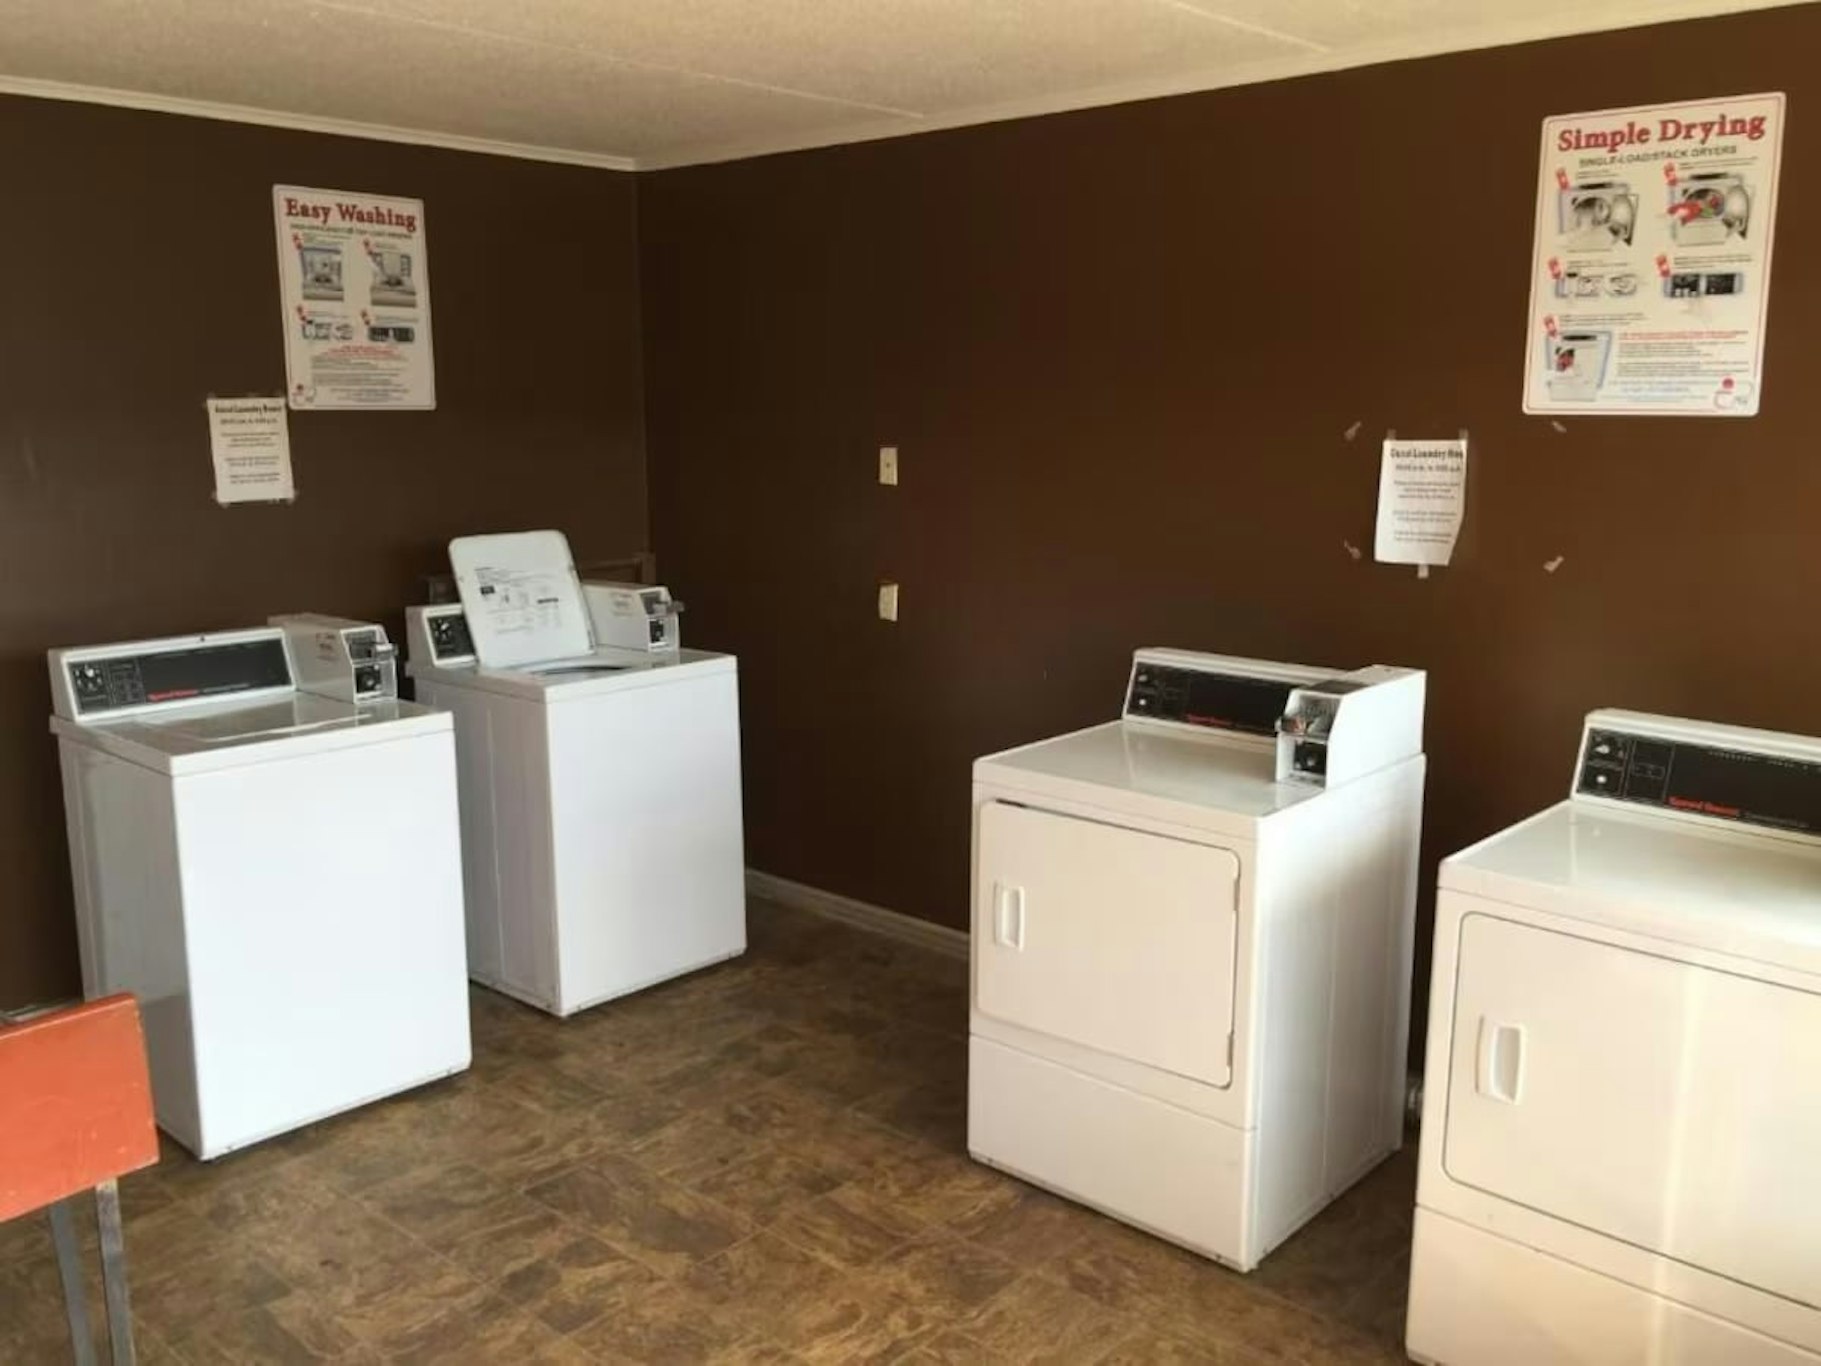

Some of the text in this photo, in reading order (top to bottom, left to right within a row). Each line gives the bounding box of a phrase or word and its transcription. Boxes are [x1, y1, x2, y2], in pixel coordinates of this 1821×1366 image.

[1558, 114, 1767, 154] Simple Drying
[1691, 145, 1738, 159] DRYERS
[284, 198, 331, 223] Easy
[336, 203, 417, 233] Washing
